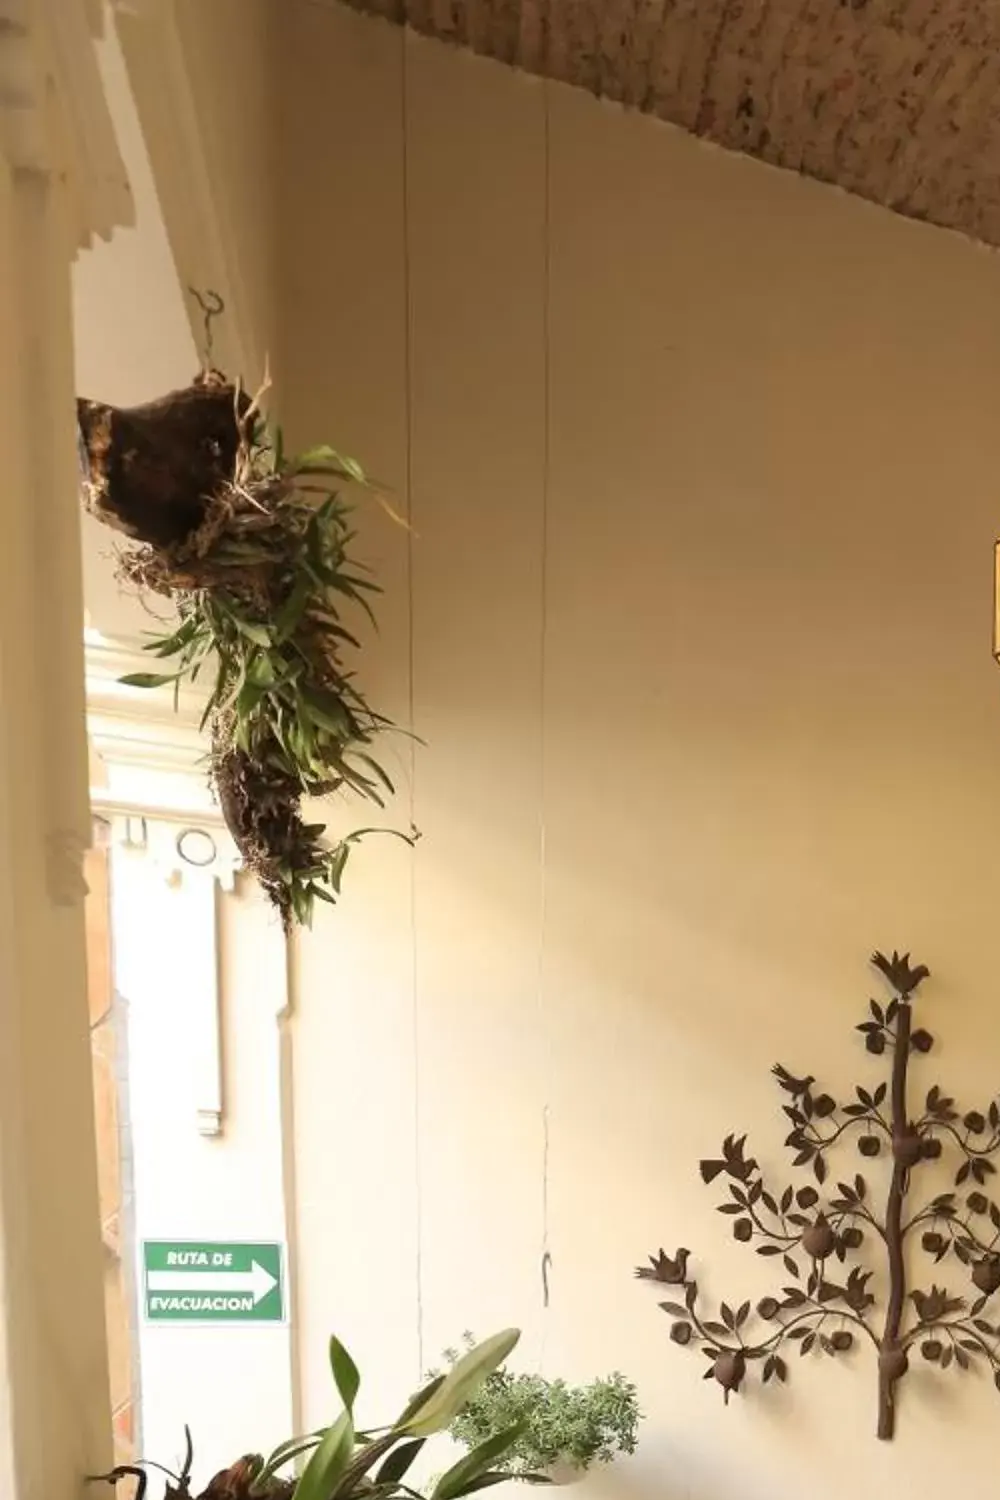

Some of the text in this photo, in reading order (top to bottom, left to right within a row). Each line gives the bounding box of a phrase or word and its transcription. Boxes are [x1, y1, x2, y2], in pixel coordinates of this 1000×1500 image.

[167, 1251, 232, 1266] RUTA DE
[150, 1297, 253, 1311] EVACUACION
